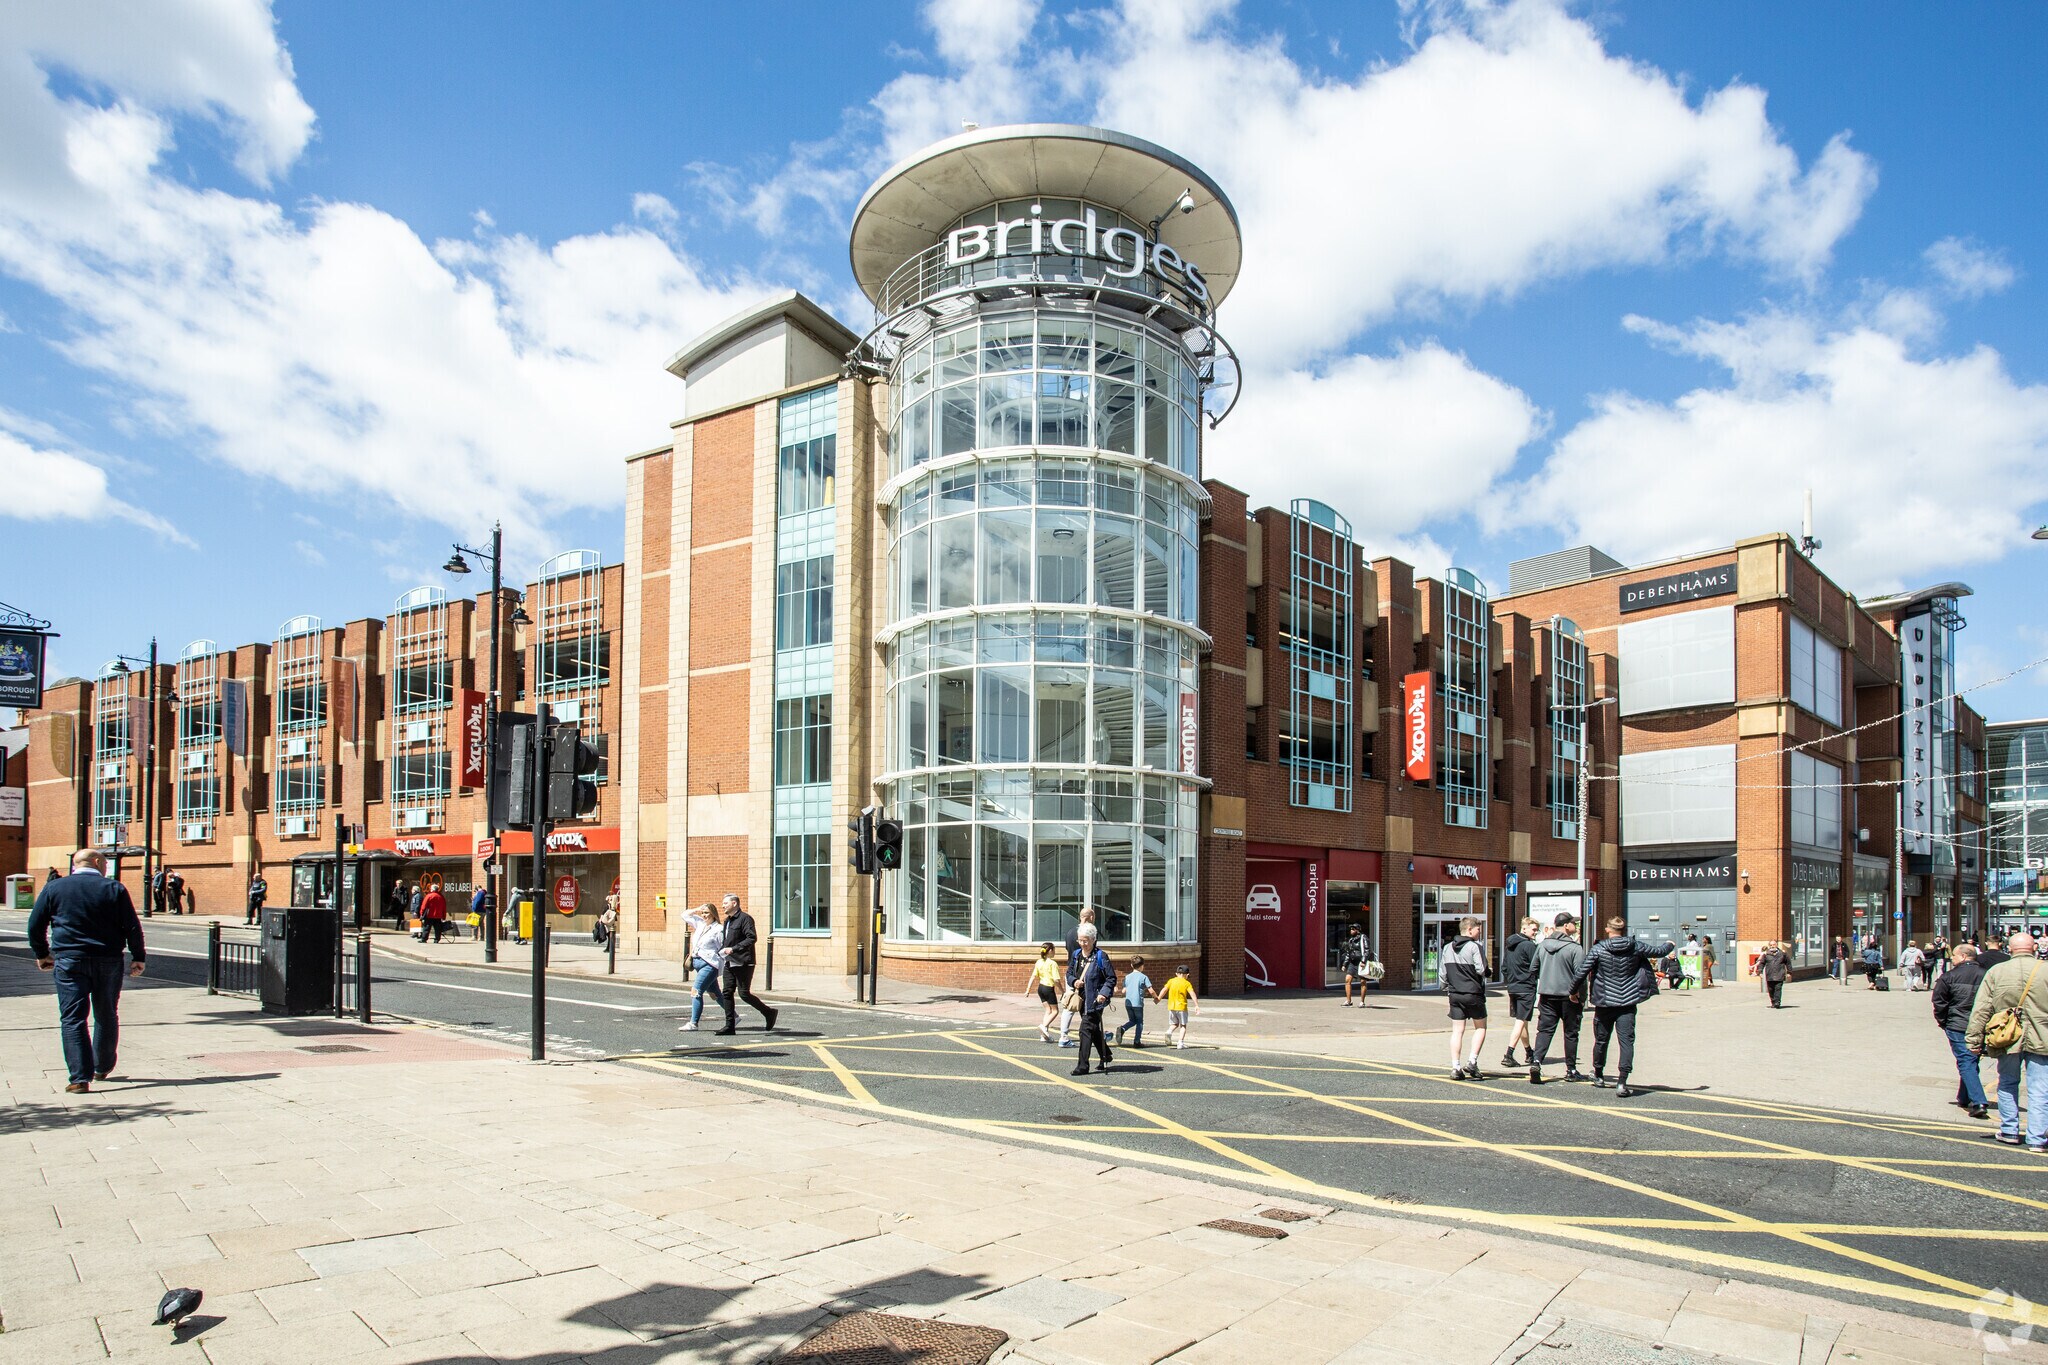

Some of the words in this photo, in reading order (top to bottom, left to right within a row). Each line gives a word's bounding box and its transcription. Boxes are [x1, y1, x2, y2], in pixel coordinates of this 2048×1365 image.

[948, 204, 1208, 301] Bridges
[1627, 574, 1728, 602] DEBENHAMS
[1629, 866, 1730, 880] DEBENHAMS
[444, 883, 455, 892] BIG
[1307, 863, 1319, 914] Bridges
